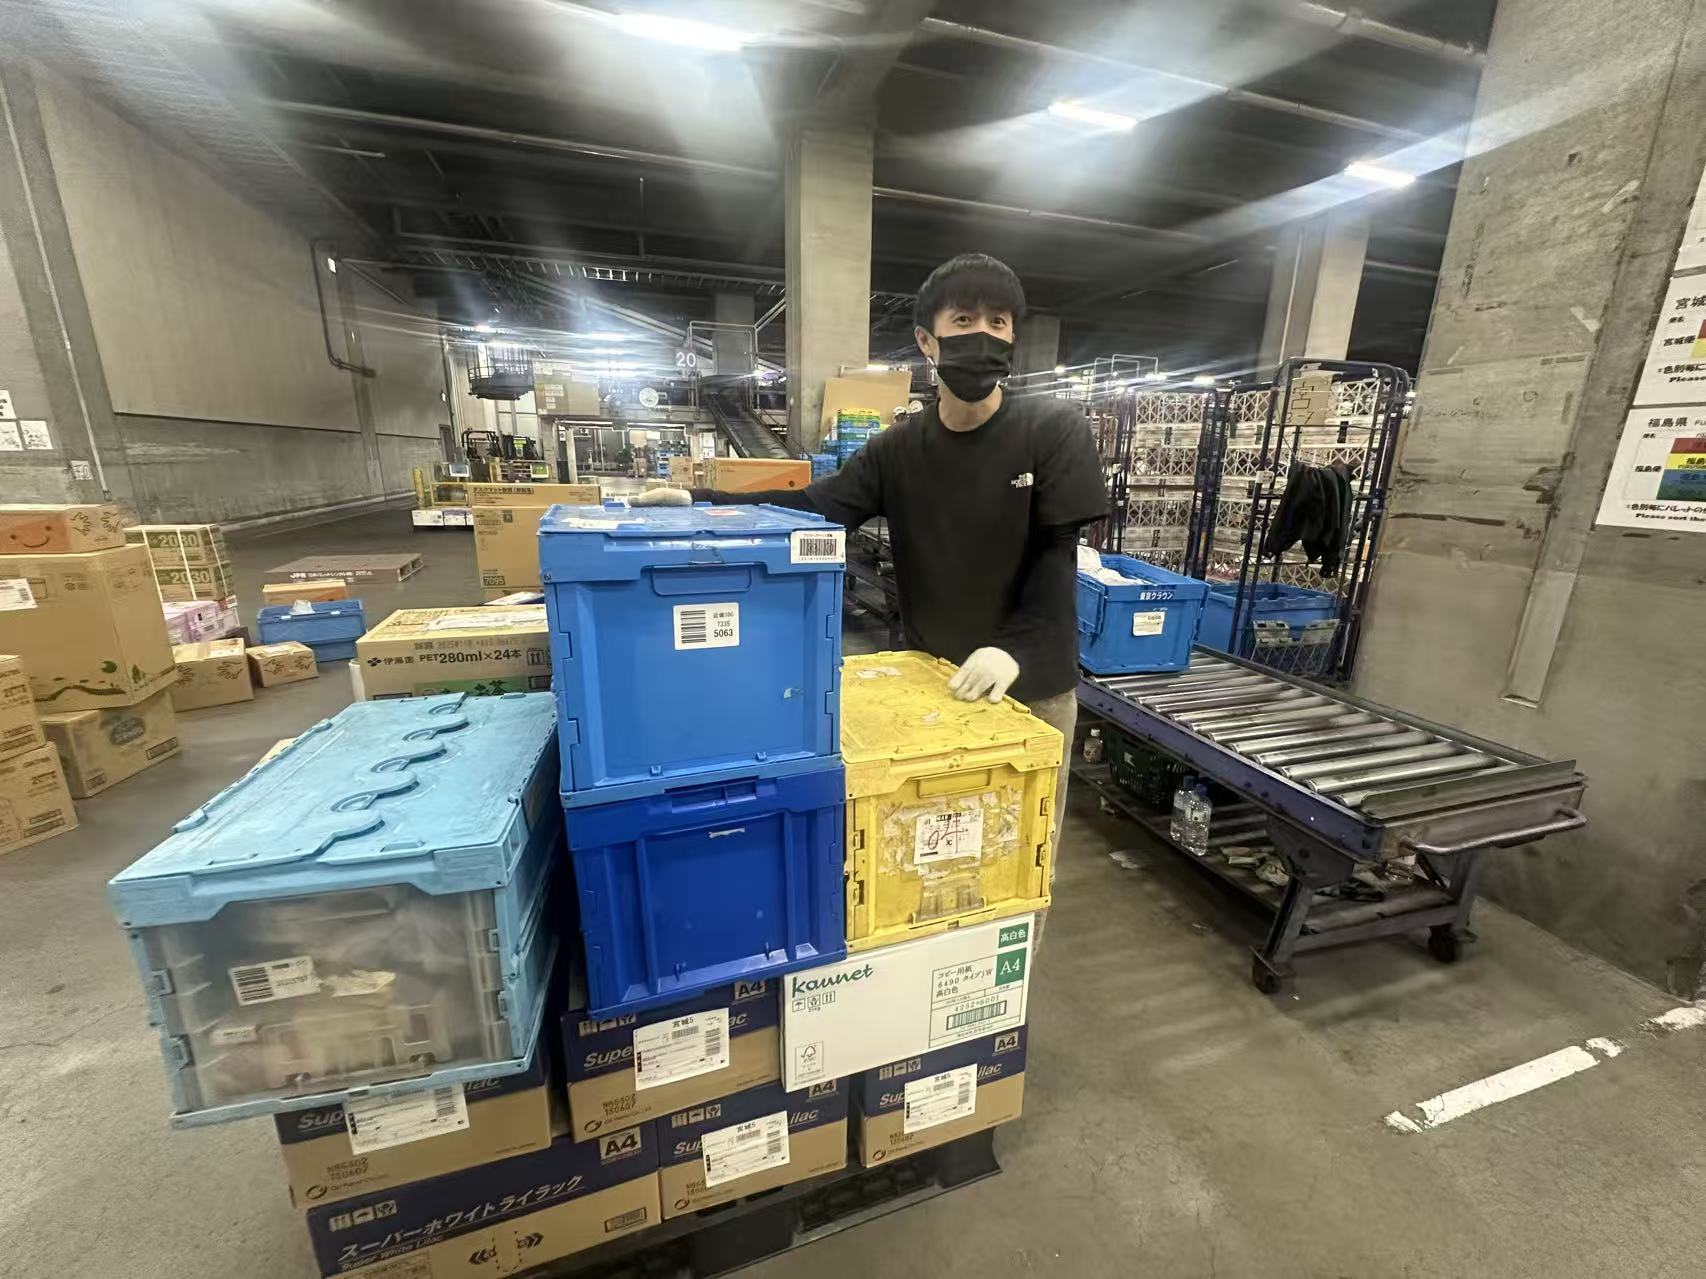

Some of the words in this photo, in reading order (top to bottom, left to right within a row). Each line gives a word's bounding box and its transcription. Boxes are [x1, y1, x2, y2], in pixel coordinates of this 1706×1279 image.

[1675, 295, 1706, 310] 宮城
[676, 352, 696, 367] 20
[1648, 417, 1688, 428] 福島県
[714, 629, 733, 637] 5063
[1000, 928, 1027, 943] 高白色
[938, 965, 973, 979] コピー用紙
[1000, 957, 1021, 975] A4
[792, 964, 874, 999] kaunet
[938, 977, 960, 989] 6490
[738, 983, 763, 998] A4
[936, 986, 959, 998] 高白色
[728, 1013, 748, 1026] ac
[997, 1035, 1017, 1050] A4
[584, 1046, 635, 1068] Supe
[977, 1063, 1003, 1080] ilac
[812, 1080, 834, 1097] A4
[879, 1092, 906, 1106] Sup
[299, 1110, 346, 1129] Sup
[789, 1109, 818, 1127] ilac
[605, 1133, 638, 1157] A4
[674, 1137, 703, 1154] Sup
[338, 1175, 584, 1261] スーパーホワイトライラック
